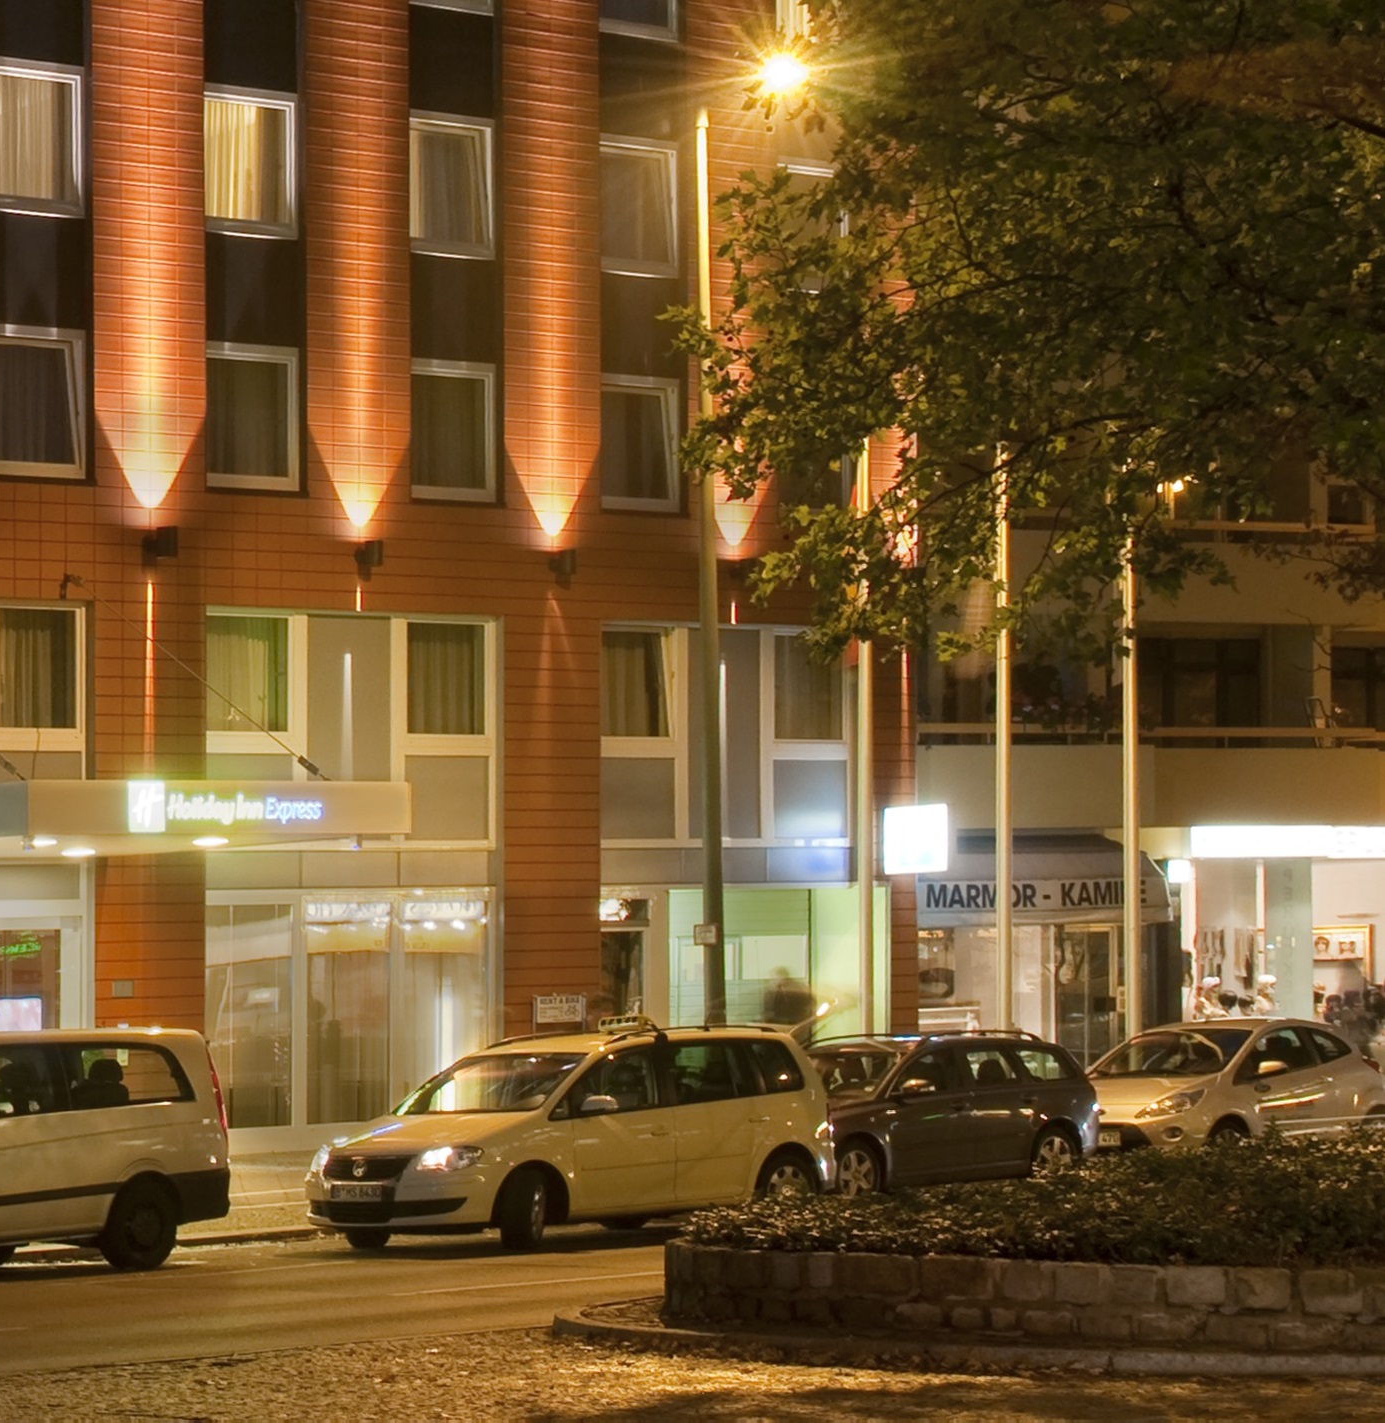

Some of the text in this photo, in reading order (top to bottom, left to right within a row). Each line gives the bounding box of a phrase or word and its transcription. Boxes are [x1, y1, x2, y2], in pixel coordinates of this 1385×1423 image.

[167, 793, 323, 825] Holiday Inn Express
[1061, 880, 1147, 907] KAMIE
